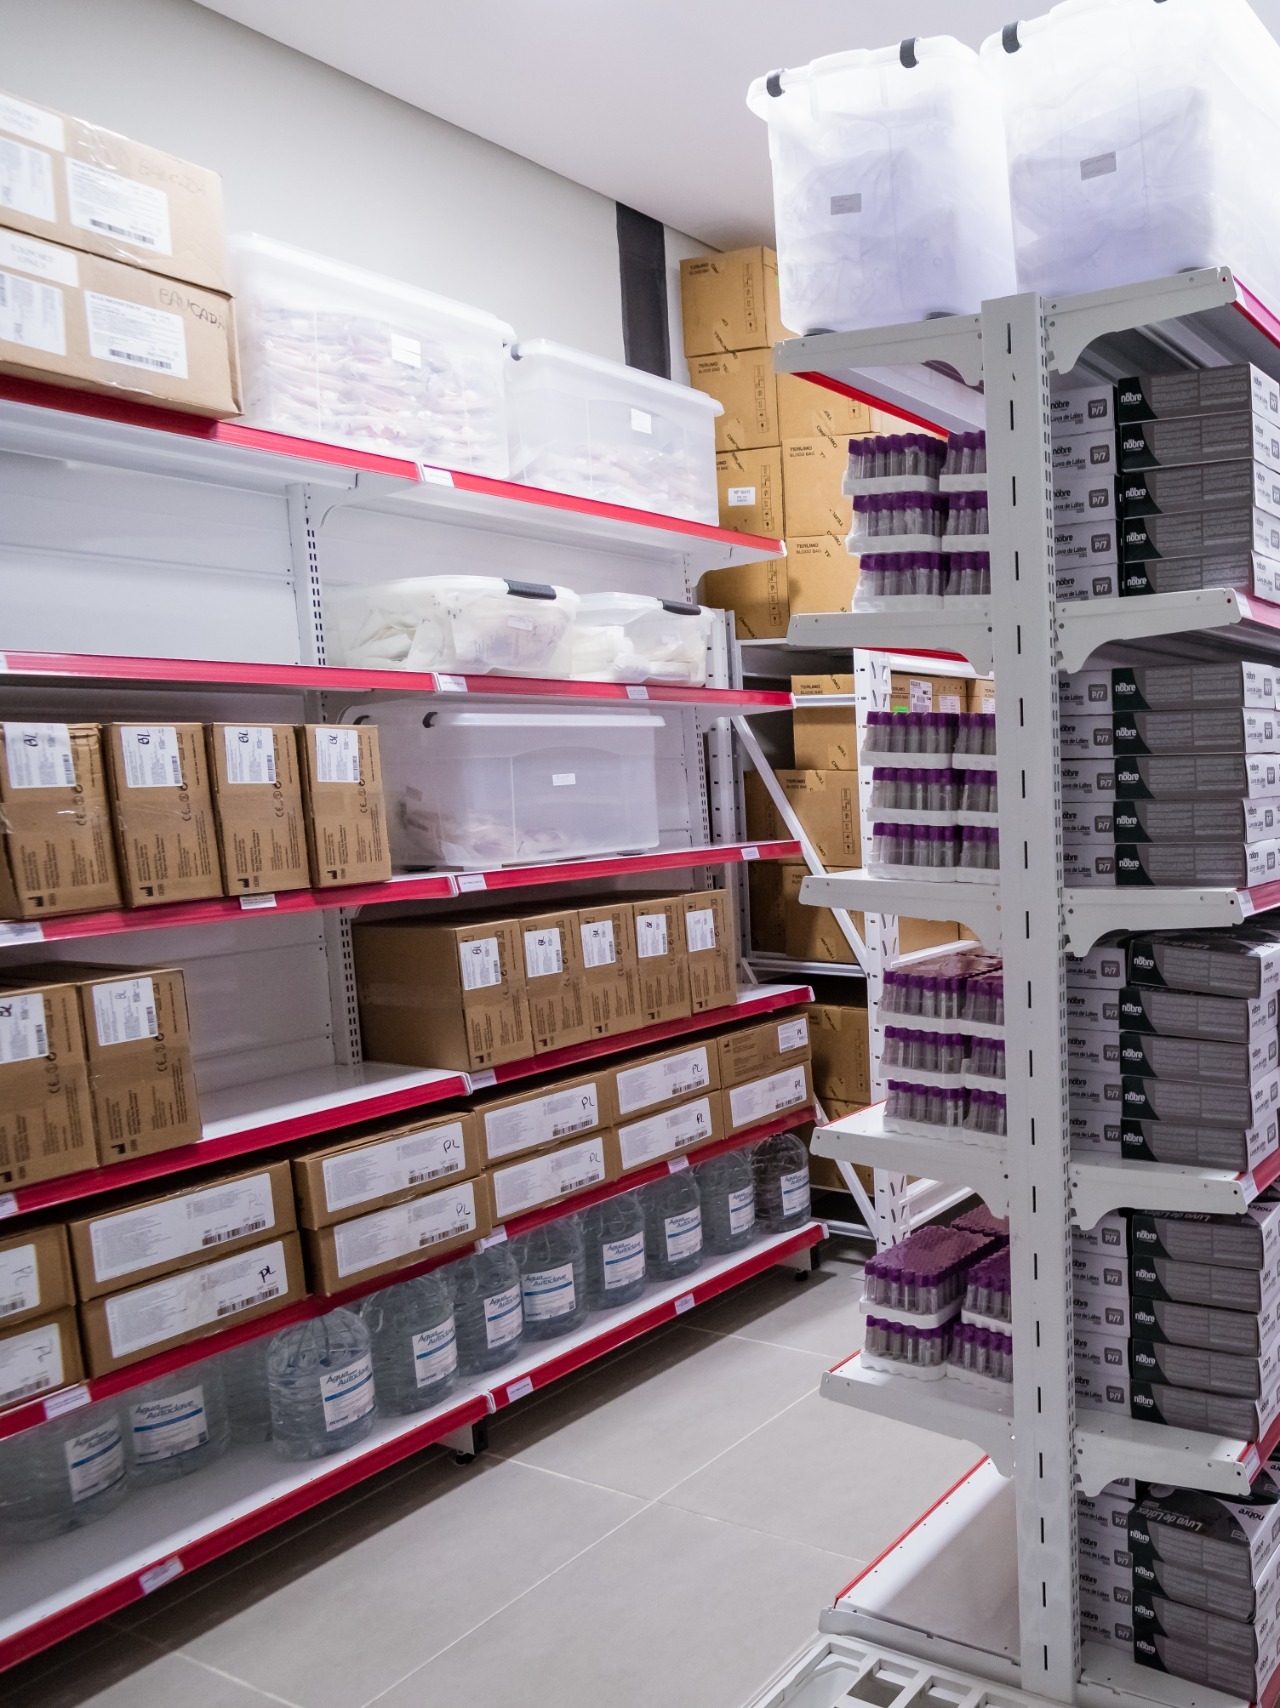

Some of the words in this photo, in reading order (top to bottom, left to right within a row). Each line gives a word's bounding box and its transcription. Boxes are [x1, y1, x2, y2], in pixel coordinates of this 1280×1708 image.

[258, 1265, 276, 1283] PL
[1163, 1513, 1176, 1523] de
[1177, 1517, 1203, 1532] Luva
